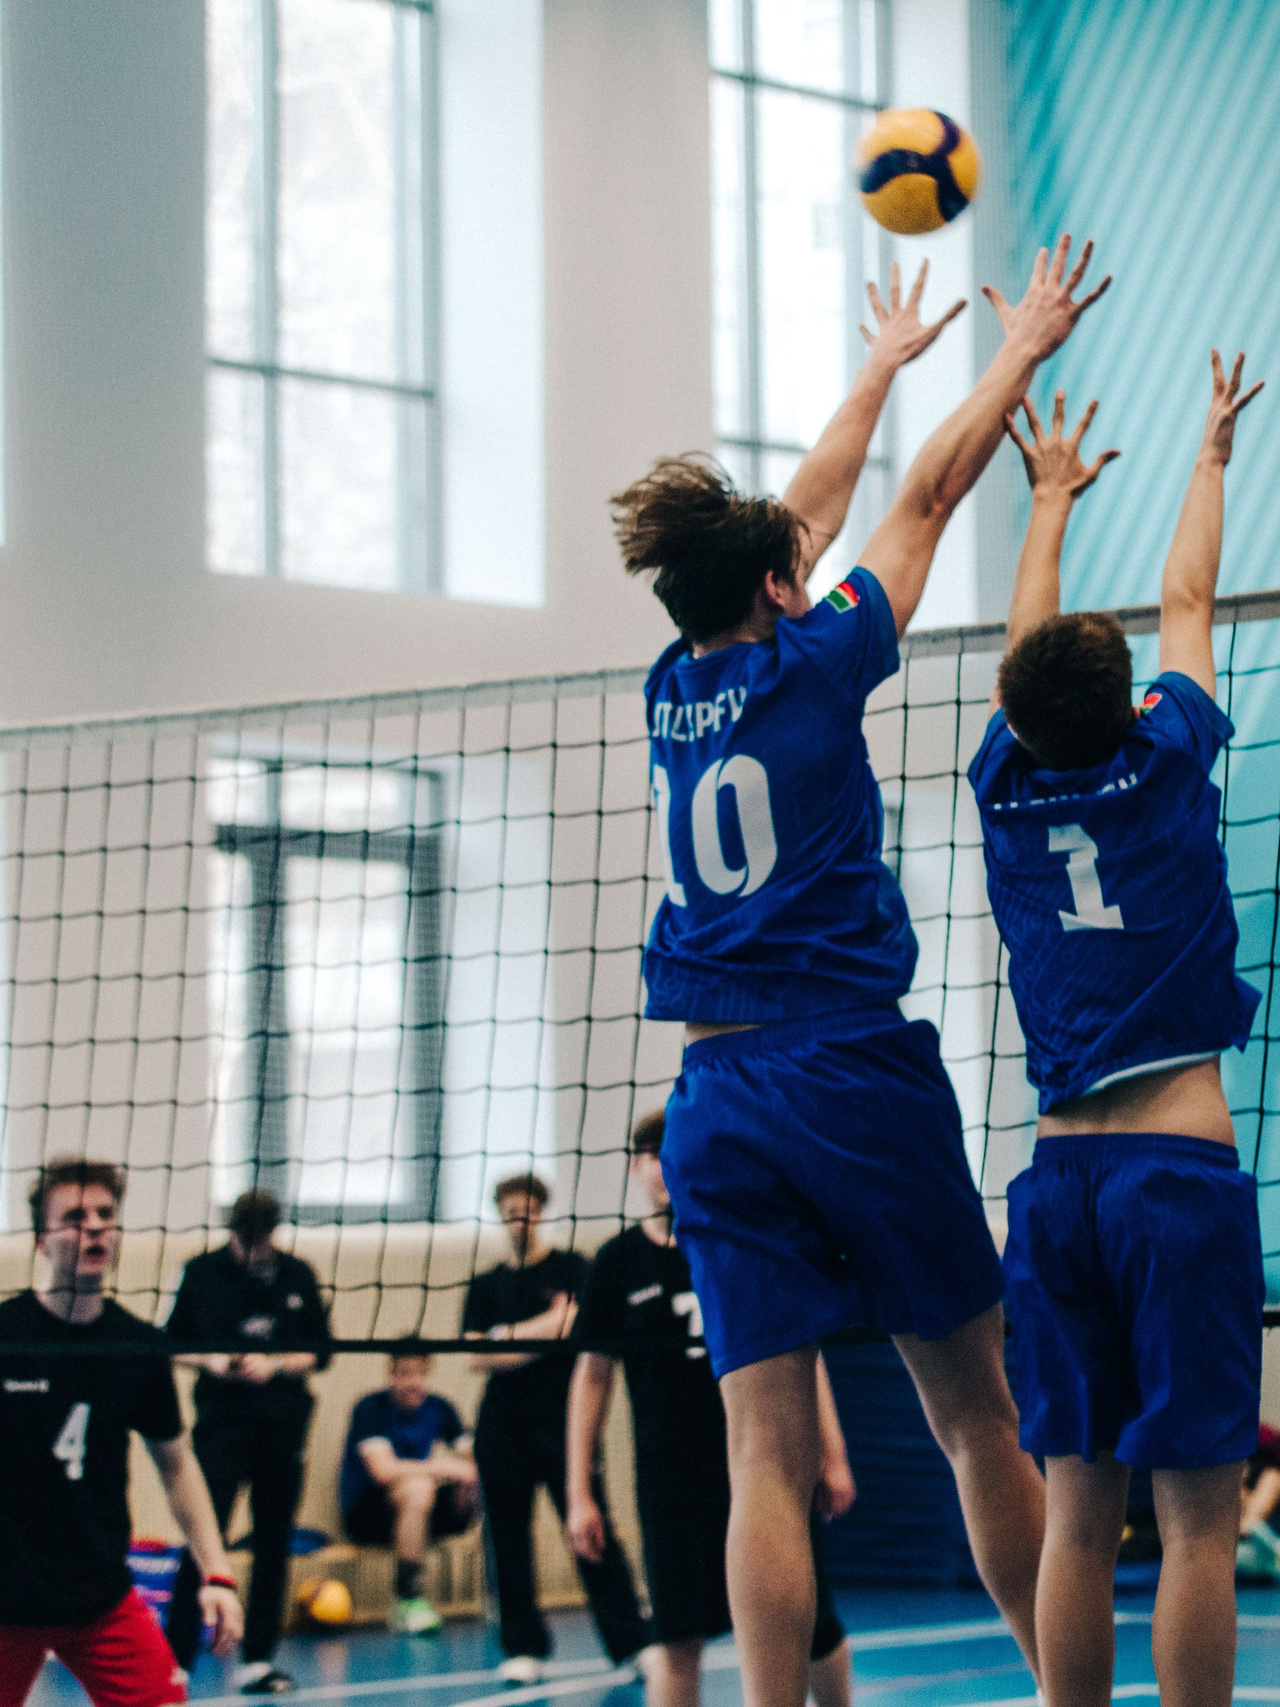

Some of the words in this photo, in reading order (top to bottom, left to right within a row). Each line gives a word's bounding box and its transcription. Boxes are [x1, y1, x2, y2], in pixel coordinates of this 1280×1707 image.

[653, 754, 778, 908] 10
[1048, 823, 1124, 932] 1
[53, 1402, 90, 1480] 4
